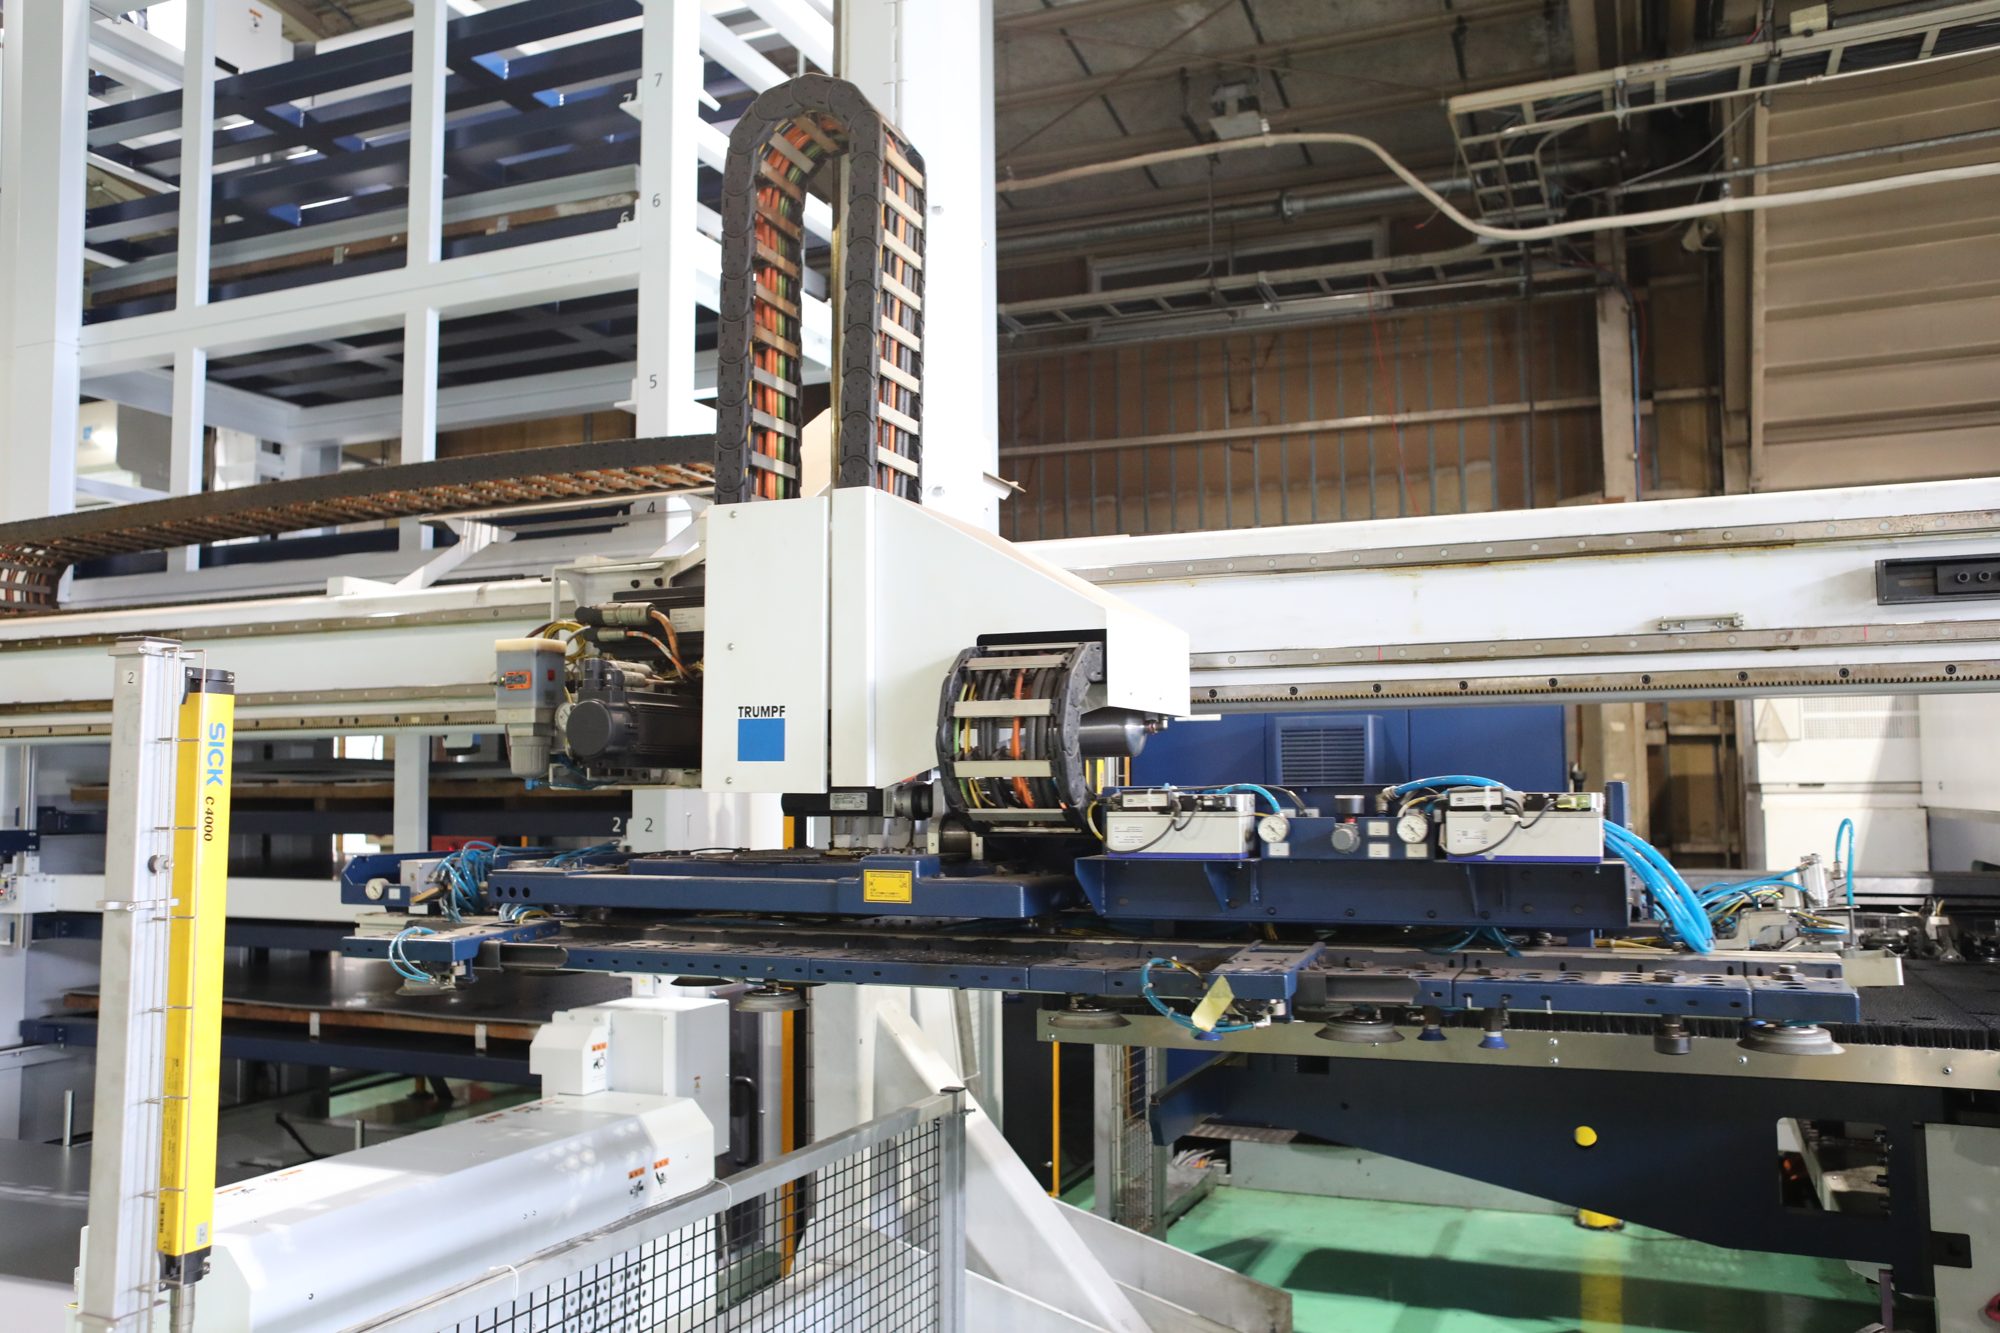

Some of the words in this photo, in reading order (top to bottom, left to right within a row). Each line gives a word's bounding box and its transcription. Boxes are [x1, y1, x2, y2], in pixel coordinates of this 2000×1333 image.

[655, 72, 663, 87] 7
[623, 92, 633, 103] 7
[652, 193, 661, 208] 6
[620, 211, 630, 223] 6
[649, 374, 657, 389] 5
[647, 501, 655, 513] 4
[127, 671, 135, 684] 2
[738, 705, 786, 718] TRUMPF
[206, 722, 226, 786] SICK
[205, 796, 215, 806] C
[203, 807, 214, 842] 4000
[612, 816, 621, 832] 2
[644, 817, 653, 832] 2
